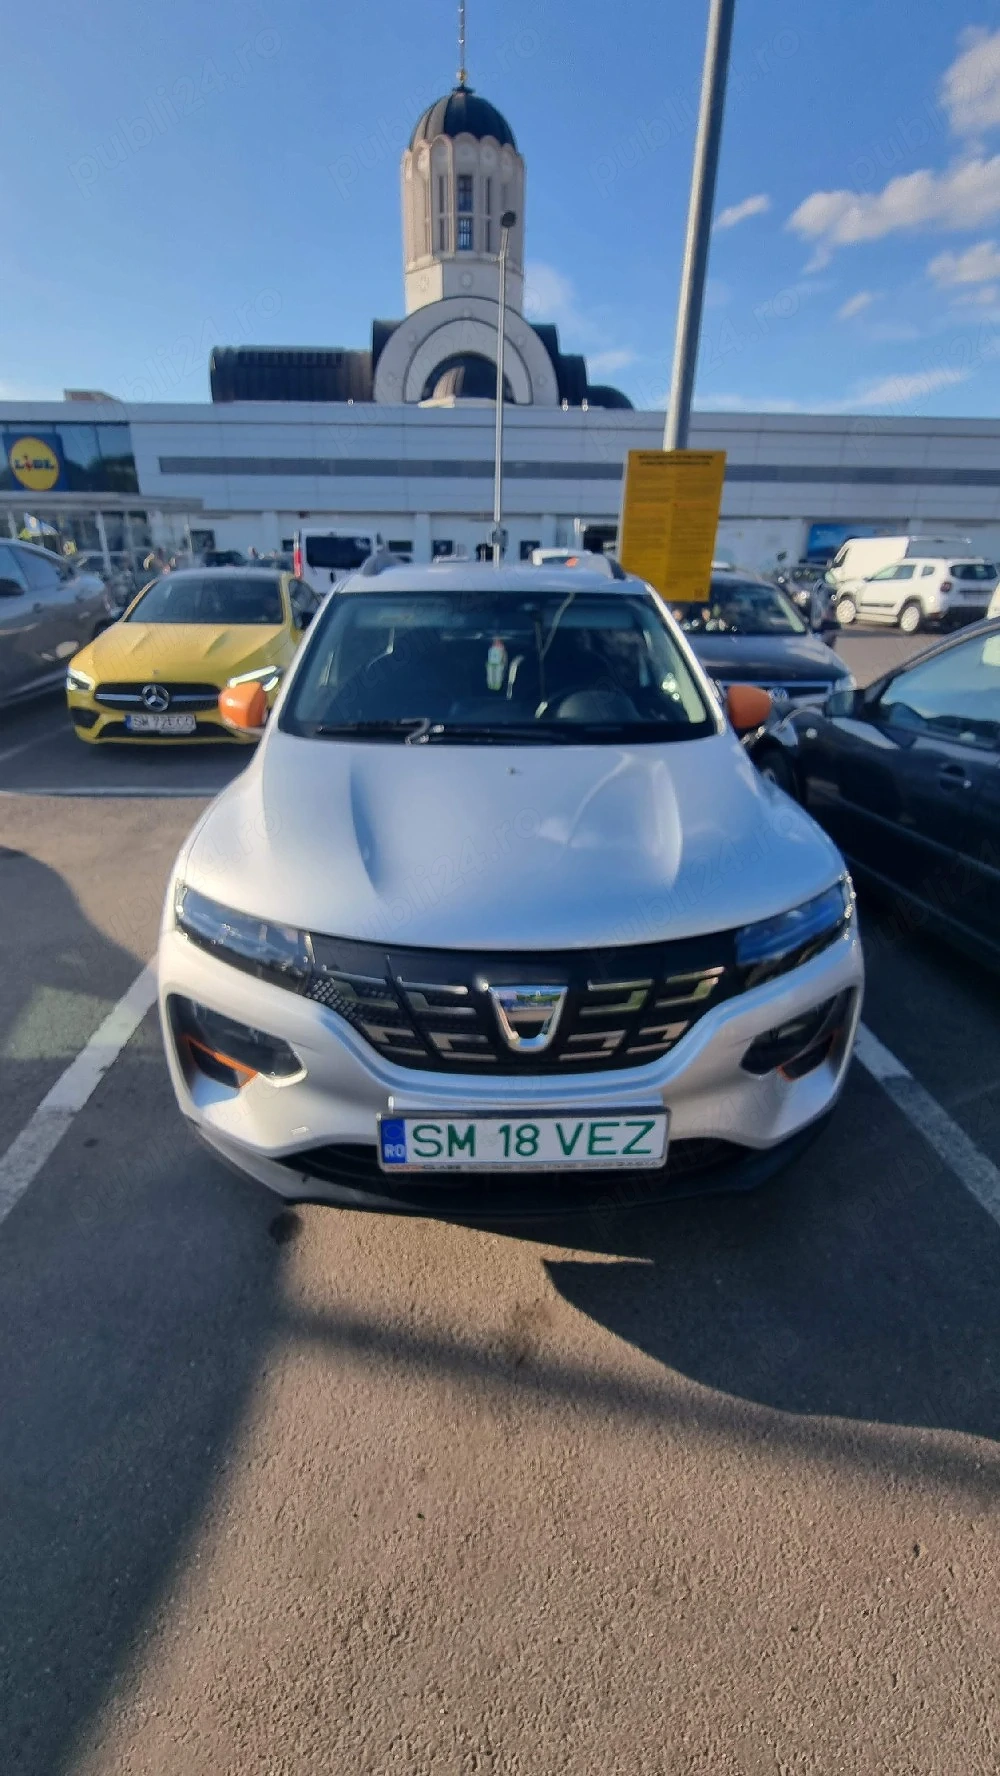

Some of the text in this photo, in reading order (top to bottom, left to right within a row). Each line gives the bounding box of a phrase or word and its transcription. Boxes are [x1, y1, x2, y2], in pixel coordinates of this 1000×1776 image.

[384, 1143, 406, 1158] RO
[412, 1119, 656, 1159] SM 18 VEZ
